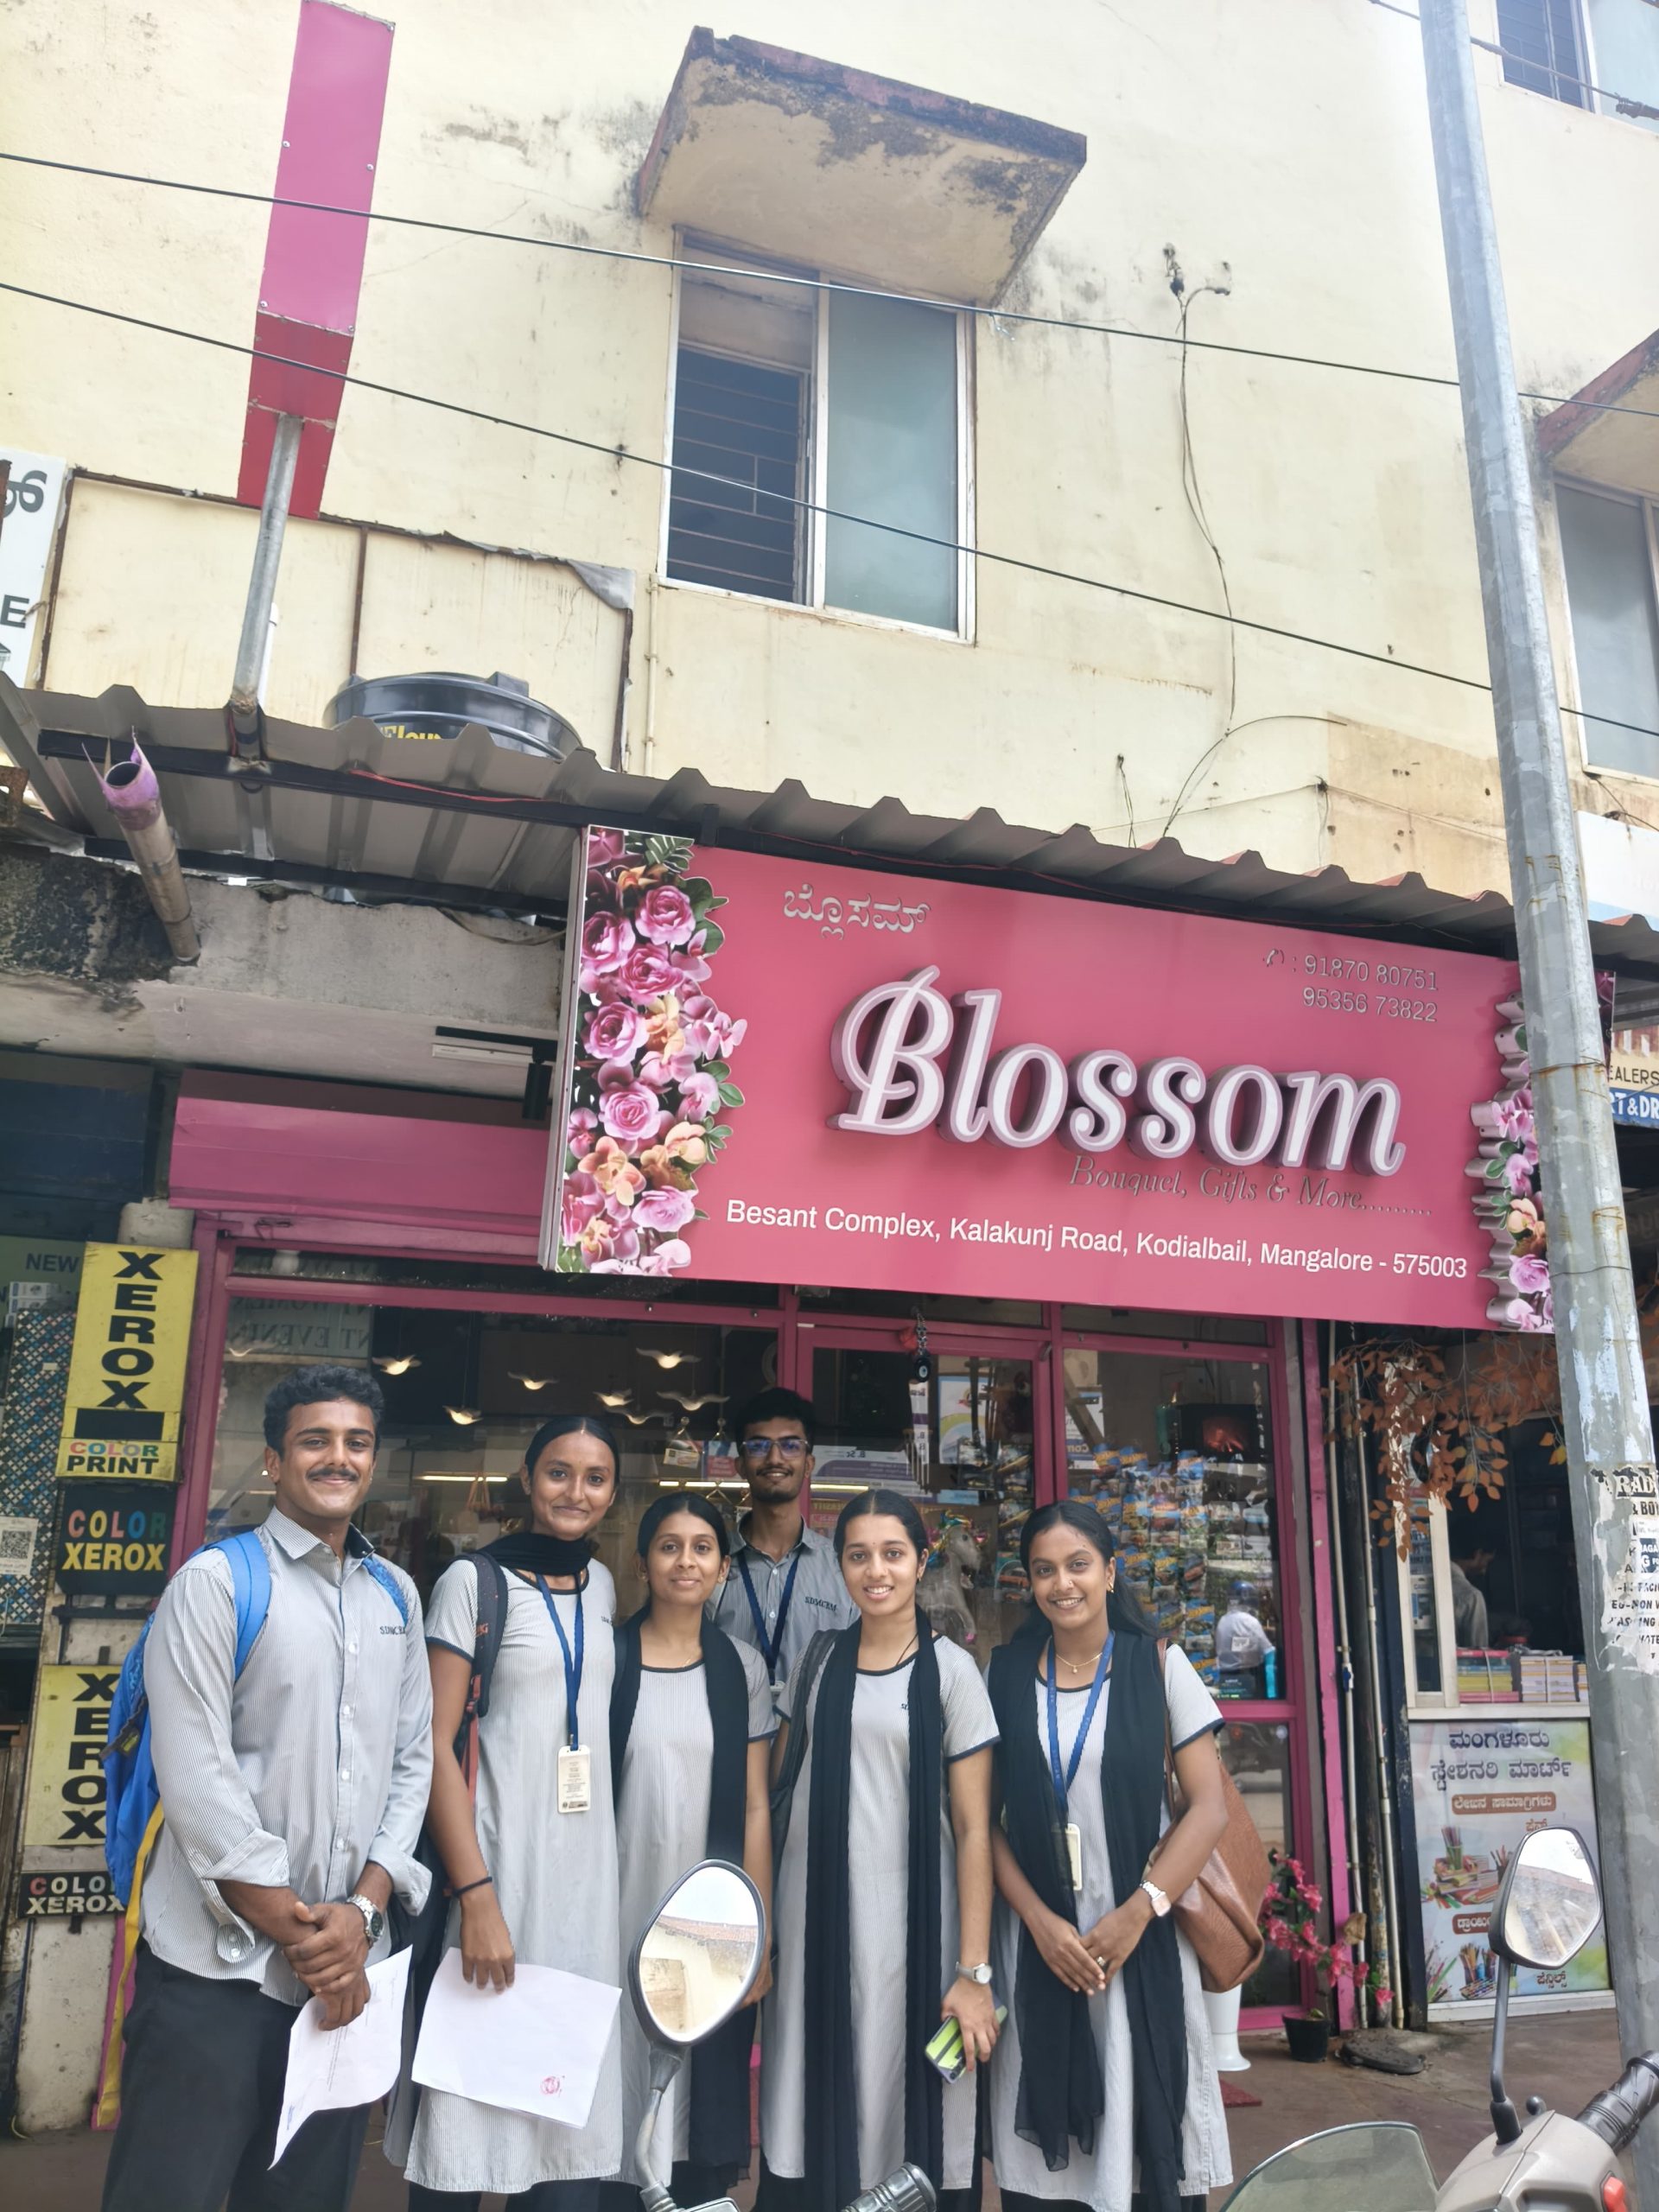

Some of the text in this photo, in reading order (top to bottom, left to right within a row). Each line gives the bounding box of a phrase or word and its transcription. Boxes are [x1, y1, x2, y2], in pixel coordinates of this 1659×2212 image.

[1305, 954, 1370, 982] 91870
[1376, 963, 1439, 991] 80751
[1303, 986, 1438, 1023] 95356 73822
[826, 965, 1407, 1178] Blossom
[1627, 1097, 1638, 1116] &
[1200, 1166, 1257, 1204] Gifts
[1267, 1173, 1289, 1203] &
[727, 1198, 818, 1229] Besant
[824, 1207, 941, 1243] Complex,
[950, 1217, 1053, 1252] Kalakunj
[1060, 1225, 1128, 1256] Road,
[1136, 1232, 1252, 1266] Kodialbail,
[1260, 1243, 1372, 1274] Mangalore
[1392, 1256, 1467, 1280] 575003
[97, 1250, 166, 1410] XEROX
[67, 1456, 159, 1474] PRINT
[70, 1441, 159, 1458] COLOR
[67, 1508, 167, 1540] COLOR
[61, 1541, 166, 1573] XEROX
[1449, 1729, 1549, 1750] ಮಂಗಳೂರು
[30, 1876, 114, 1896] COLO
[26, 1895, 125, 1915] XEROX
